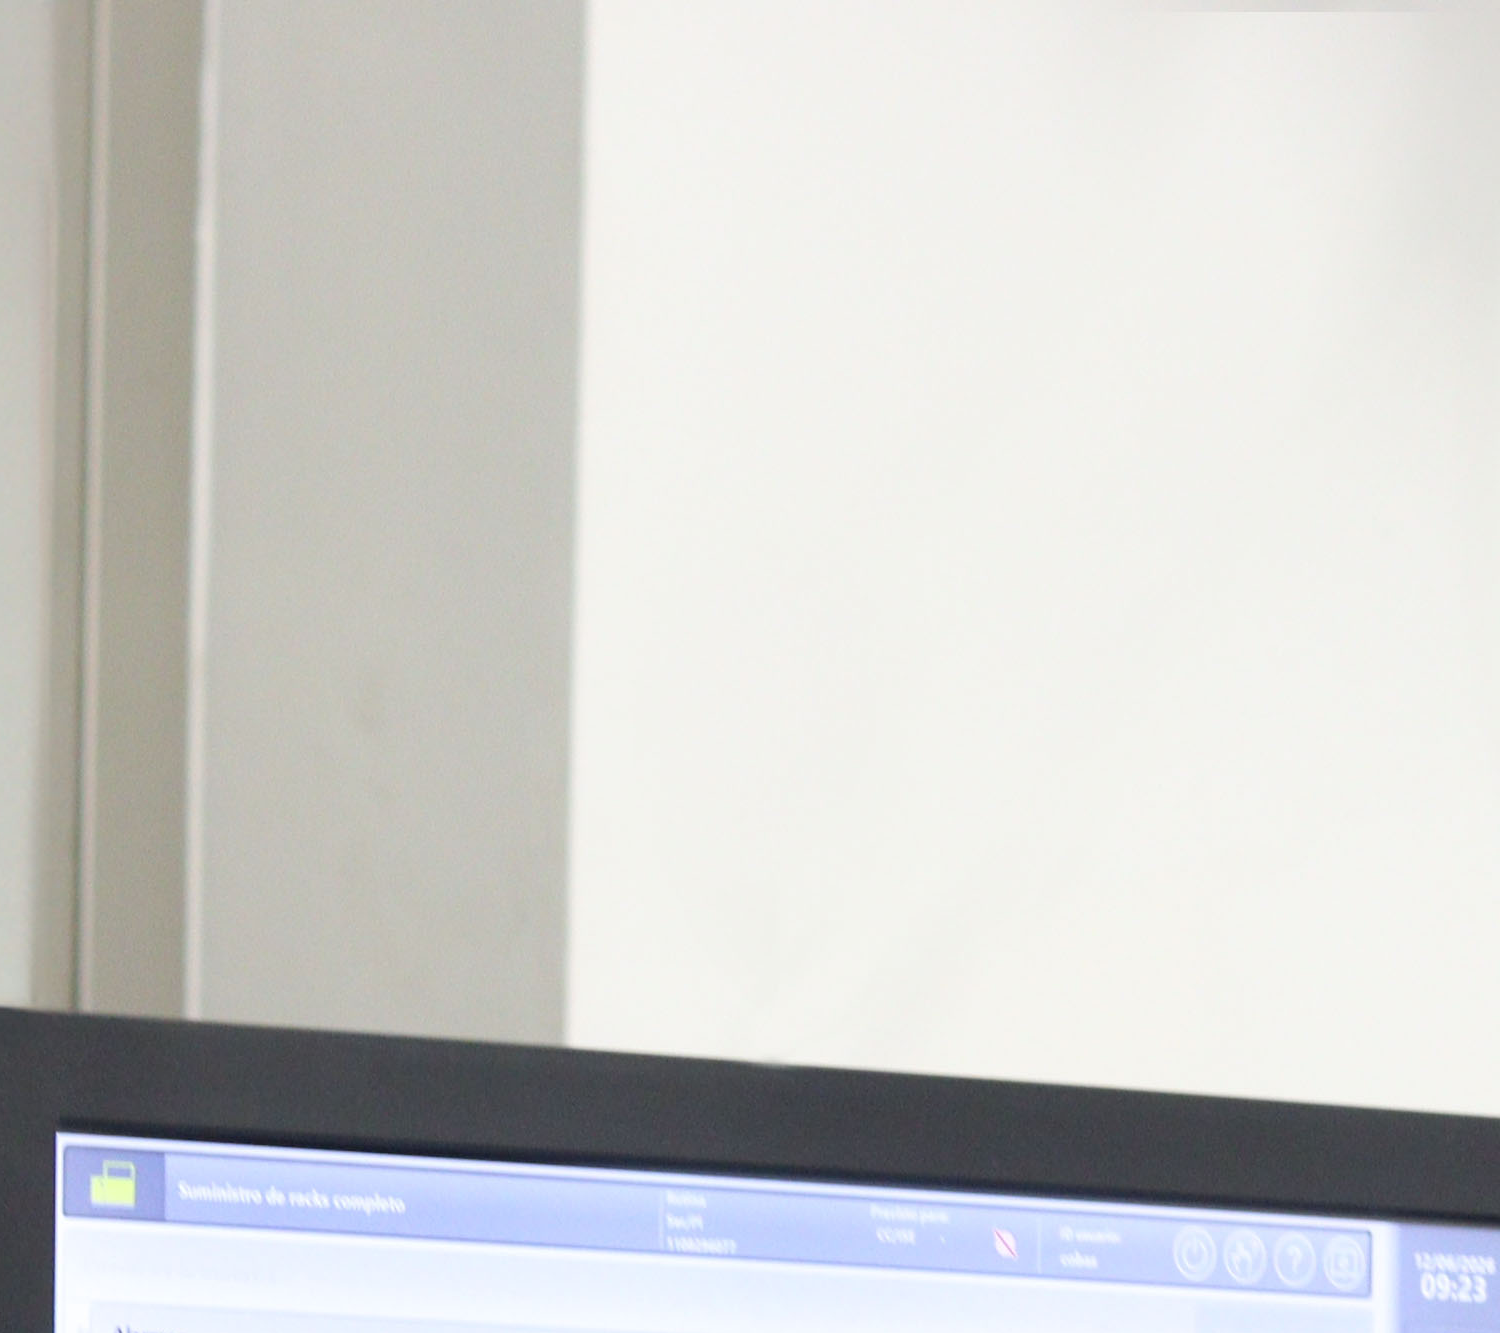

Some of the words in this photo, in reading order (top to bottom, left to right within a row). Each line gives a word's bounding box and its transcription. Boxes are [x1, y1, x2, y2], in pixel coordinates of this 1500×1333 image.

[179, 1180, 262, 1205] Suministro
[266, 1185, 286, 1206] de
[334, 1191, 406, 1215] completo
[1420, 1271, 1488, 1304] 09:23
